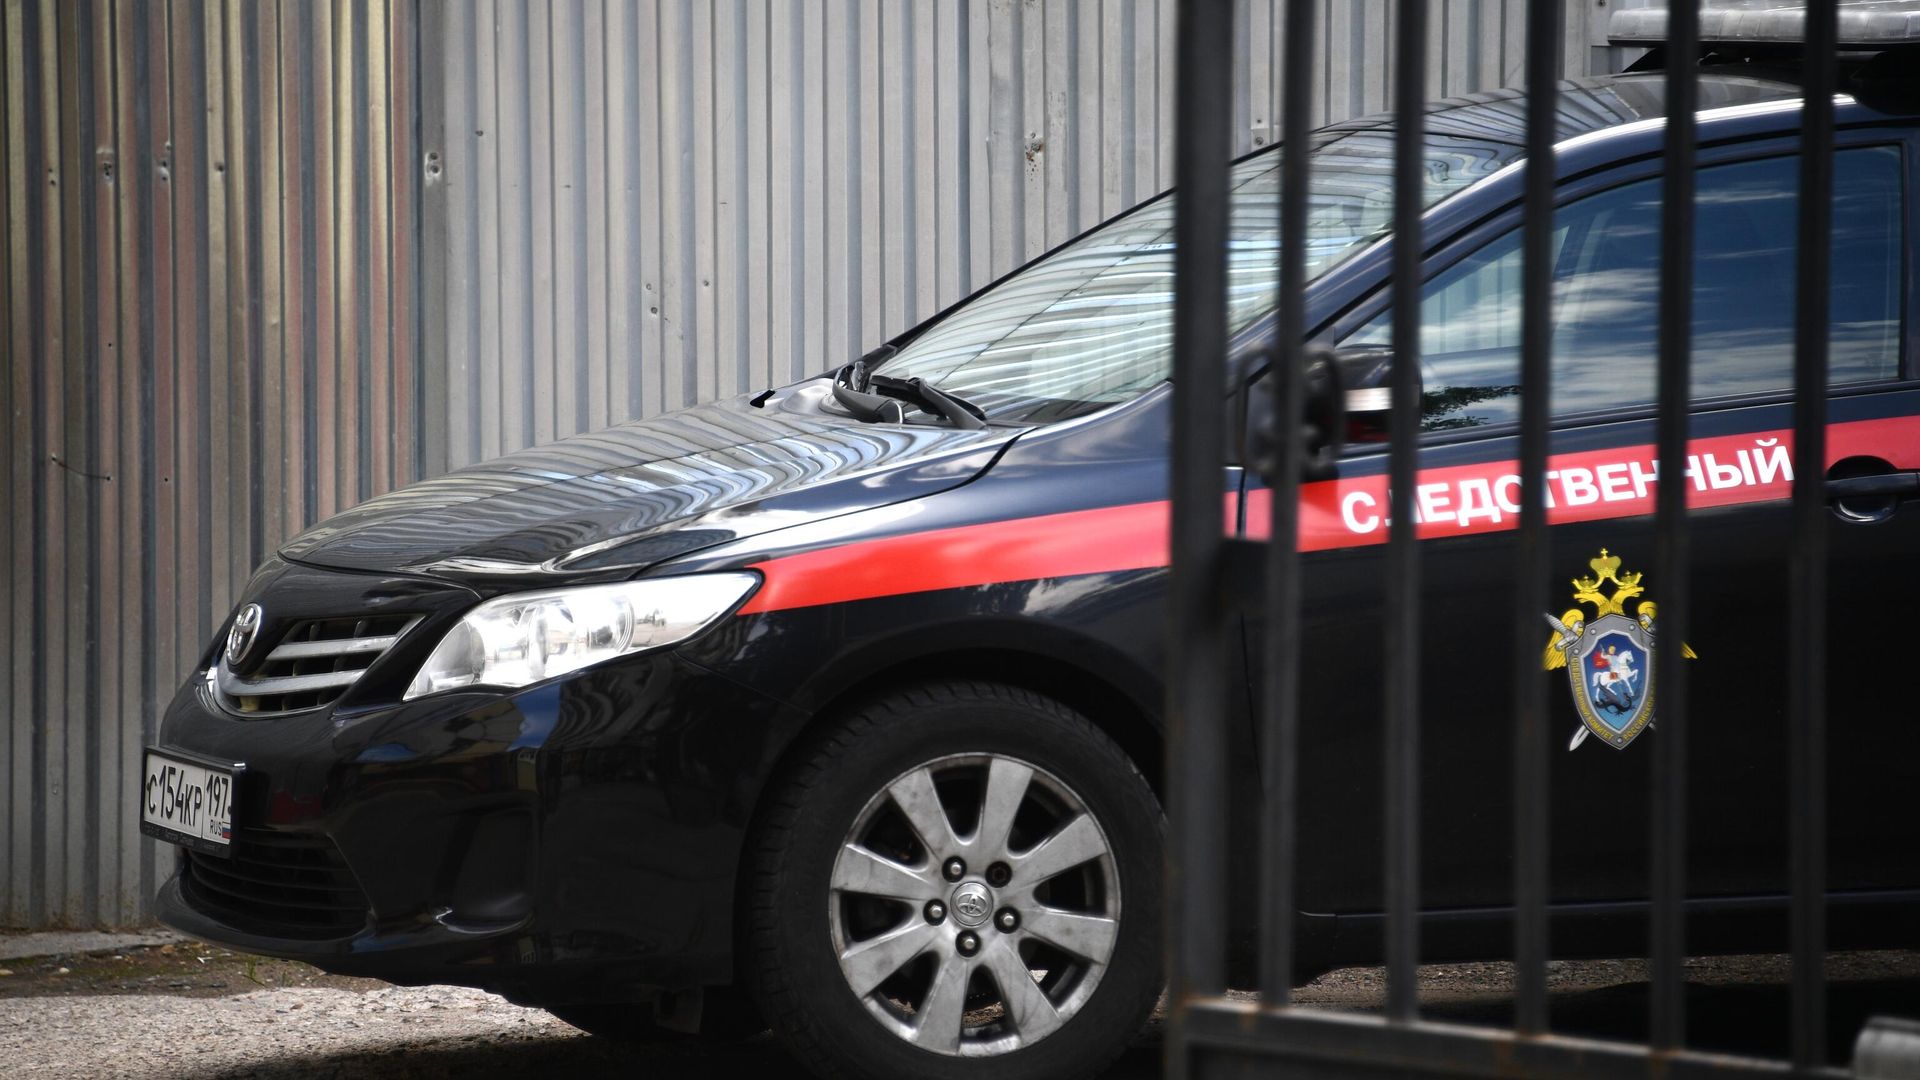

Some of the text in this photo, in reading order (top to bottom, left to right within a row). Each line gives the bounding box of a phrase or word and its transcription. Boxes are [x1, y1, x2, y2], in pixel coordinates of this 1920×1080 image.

[148, 764, 229, 827] С154КР 197
[209, 818, 222, 836] RUS
